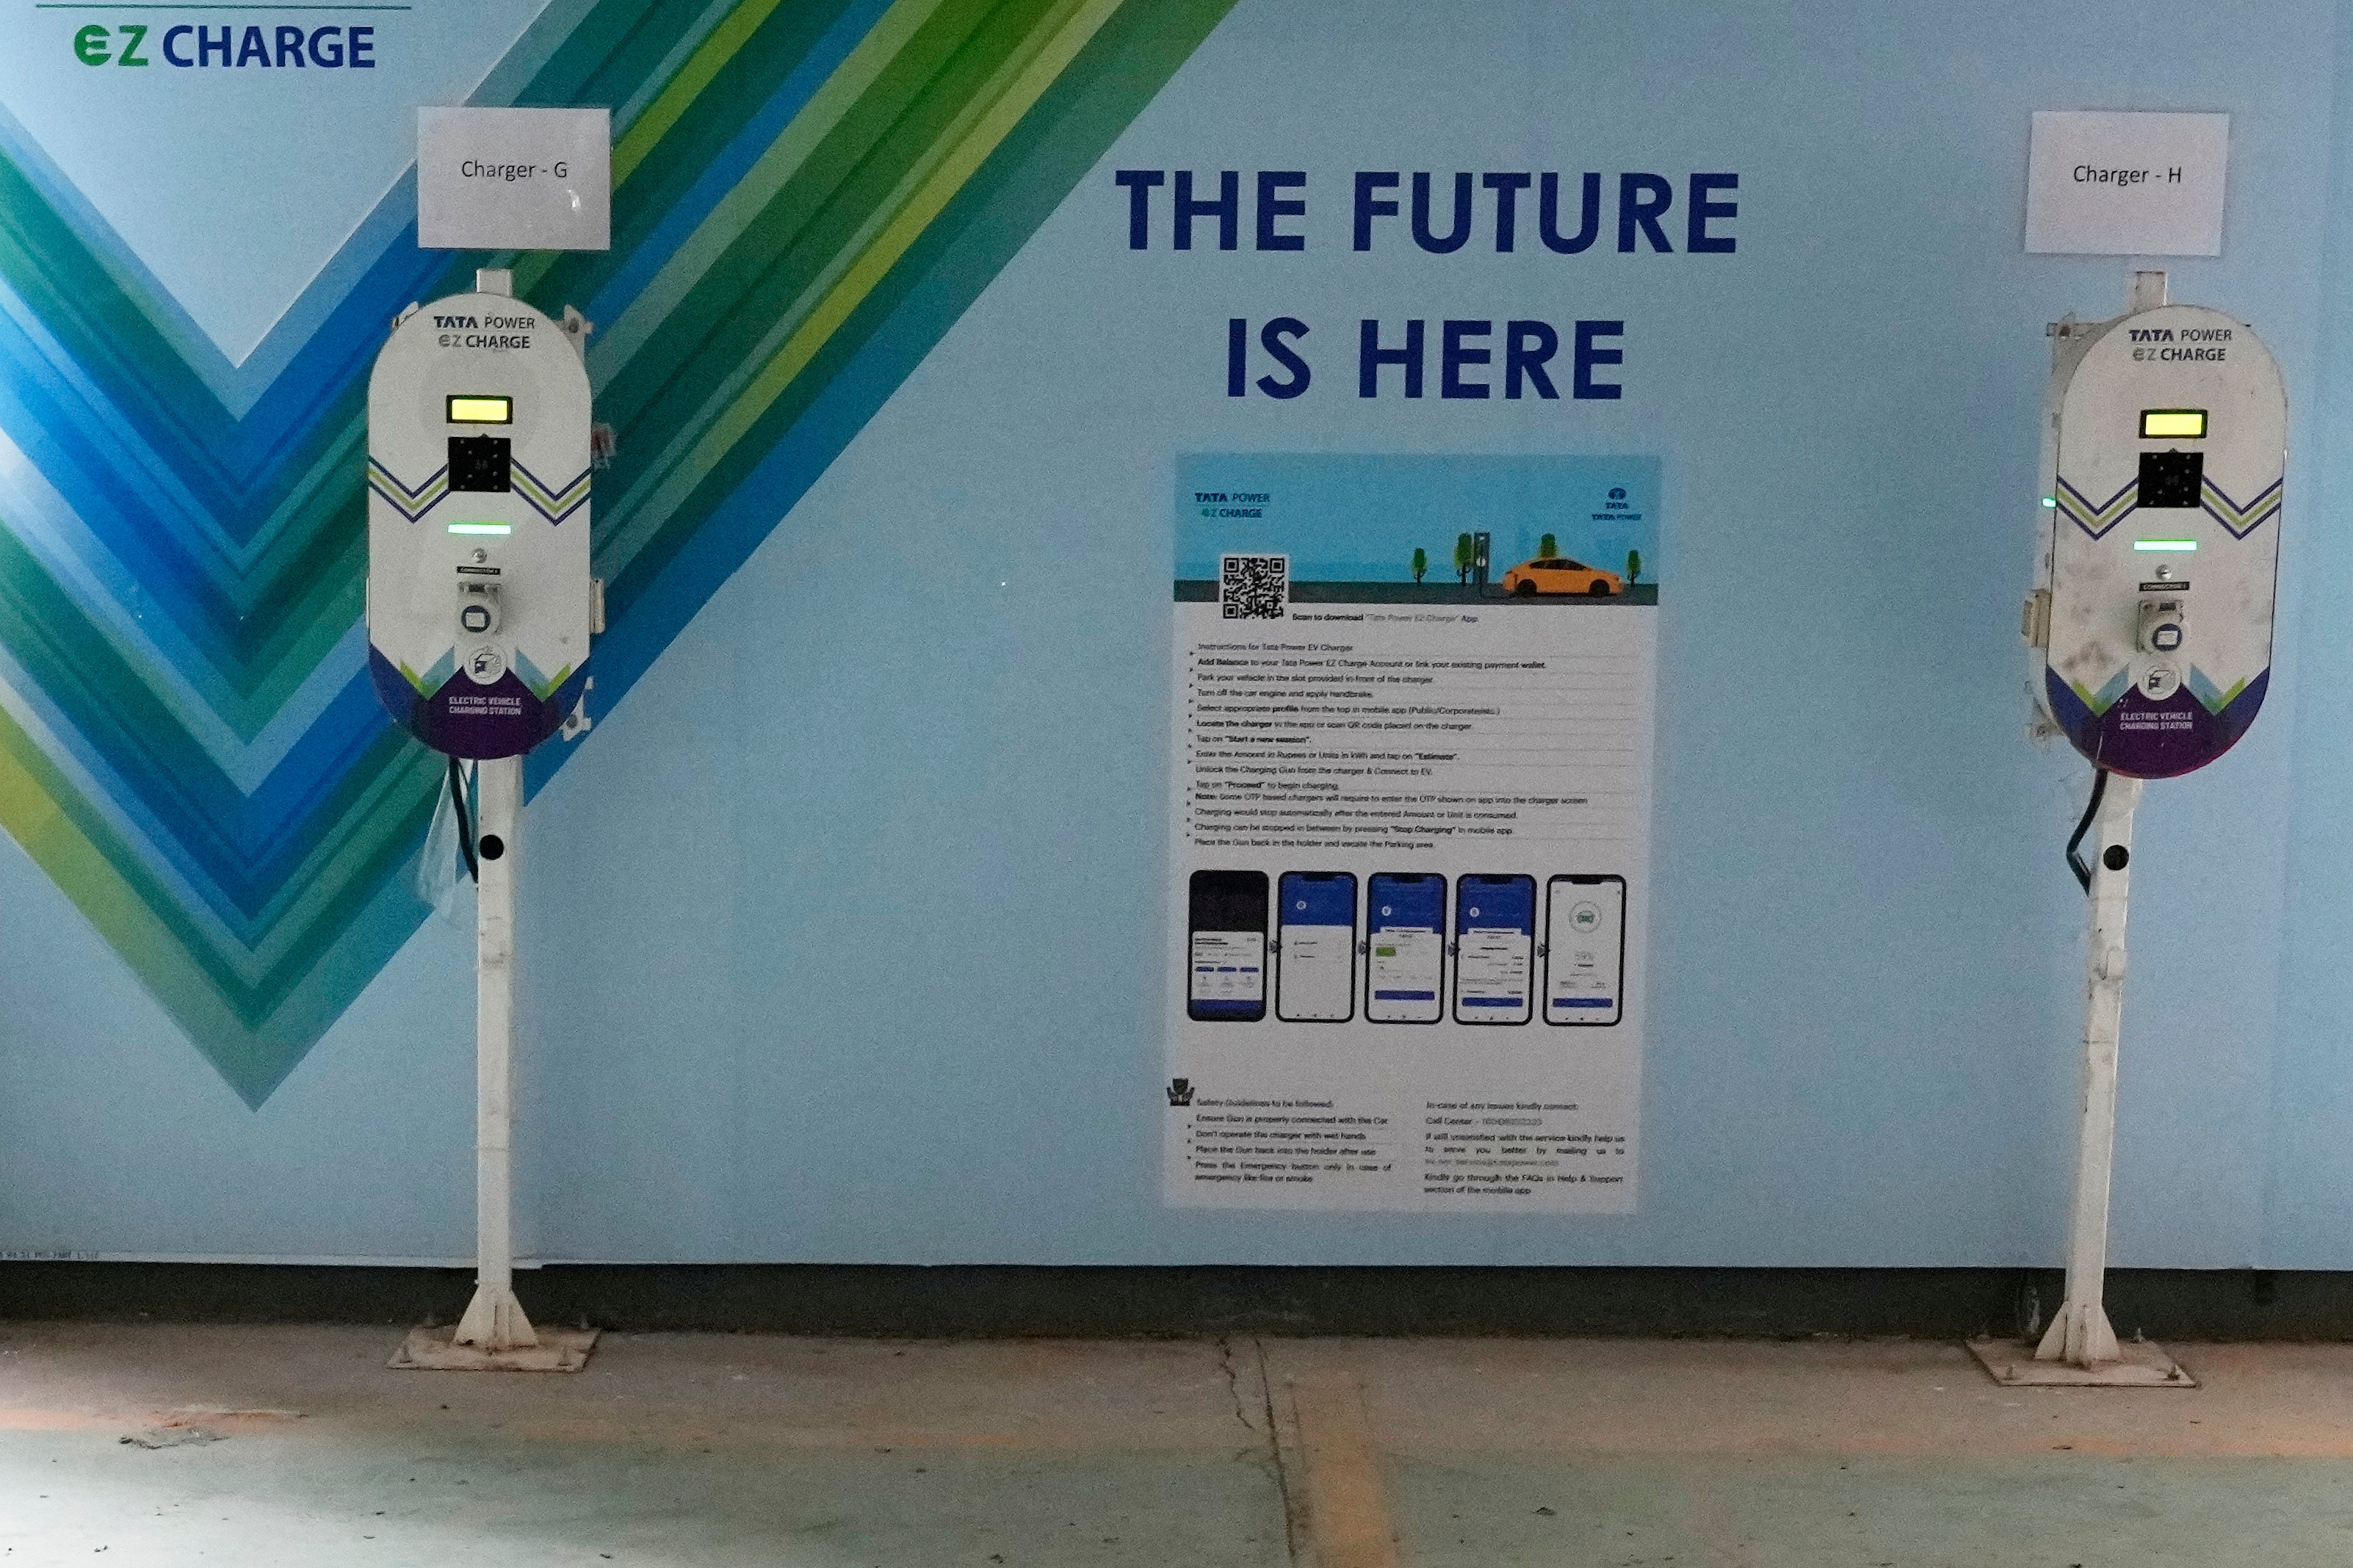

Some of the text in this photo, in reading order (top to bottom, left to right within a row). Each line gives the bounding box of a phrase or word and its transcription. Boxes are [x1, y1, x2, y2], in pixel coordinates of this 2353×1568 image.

[162, 25, 376, 68] CHARGE
[462, 159, 536, 181] Charger
[554, 162, 568, 178] G
[2074, 165, 2150, 186] Charger
[2169, 167, 2181, 183] H
[1115, 170, 1739, 254] THE FUTURE
[433, 316, 535, 329] TATA POWER
[2129, 329, 2233, 342] TATA POWER
[466, 335, 531, 349] CHARGE
[1227, 317, 1624, 400] IS HERE
[2161, 348, 2226, 361] CHARGE
[1194, 493, 1271, 502] TATA POWER
[1219, 508, 1262, 519] CHARGE
[1292, 613, 1312, 621] Scan
[1248, 643, 1259, 651] for
[1262, 643, 1278, 651] Tata
[1197, 657, 1214, 665] Add
[1261, 660, 1278, 668] your
[1337, 660, 1367, 668] Charge
[1451, 660, 1482, 670] existing
[1484, 661, 1519, 670] payment
[1197, 673, 1213, 681] Park
[1308, 674, 1343, 684] provided
[1387, 675, 1400, 683] the
[1198, 688, 1215, 696] Turn
[1259, 689, 1286, 698] engine
[1305, 690, 1328, 699] apply
[449, 697, 522, 706] ELECTRIC VEHICLE
[448, 706, 522, 715] CHARGING STATION
[1197, 704, 1221, 712] Select
[1224, 704, 1270, 714] appropriate
[1272, 705, 1298, 714] profile
[1321, 705, 1334, 713] the
[1337, 705, 1350, 715] top
[1391, 707, 1406, 715] app
[2120, 712, 2193, 721] ELECTRIC VEHICLE
[1226, 720, 1239, 728] the
[1240, 720, 1272, 729] charger
[1283, 720, 1298, 729] the
[1299, 722, 1315, 730] app
[1384, 722, 1411, 731] placed
[1425, 722, 1439, 730] the
[2119, 721, 2193, 730] CHARGING STATION
[1196, 734, 1210, 744] Tap
[1196, 750, 1216, 758] Enter
[1387, 752, 1400, 762] tap
[1516, 1102, 1541, 1111] kindly
[1425, 1116, 1442, 1124] Call
[1475, 1148, 1491, 1156] you
[1500, 1146, 1526, 1155] better
[1467, 1186, 1481, 1194] the
[1482, 1186, 1513, 1194] mobile
